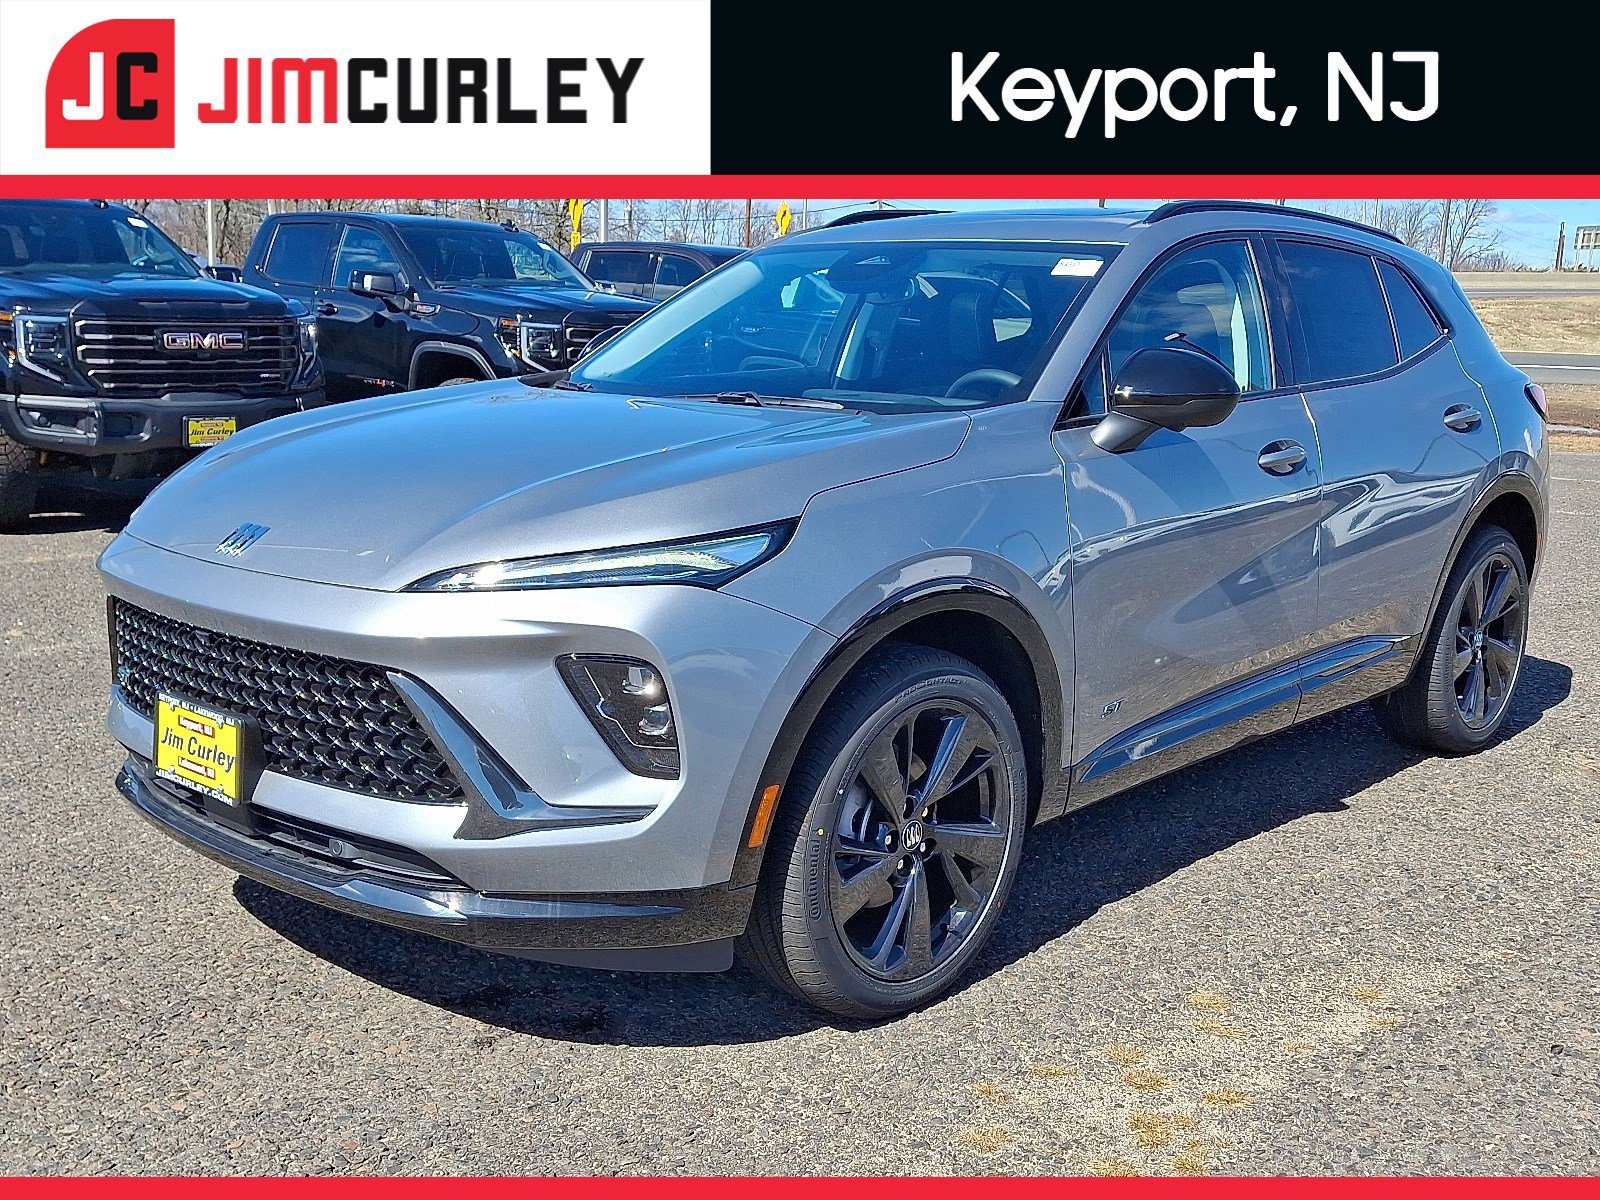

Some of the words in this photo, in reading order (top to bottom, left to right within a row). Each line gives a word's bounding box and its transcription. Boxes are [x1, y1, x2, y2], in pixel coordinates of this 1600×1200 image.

[163, 333, 243, 349] GMC
[161, 727, 184, 751] Jim
[187, 736, 236, 774] Curley
[807, 835, 823, 921] Continental
